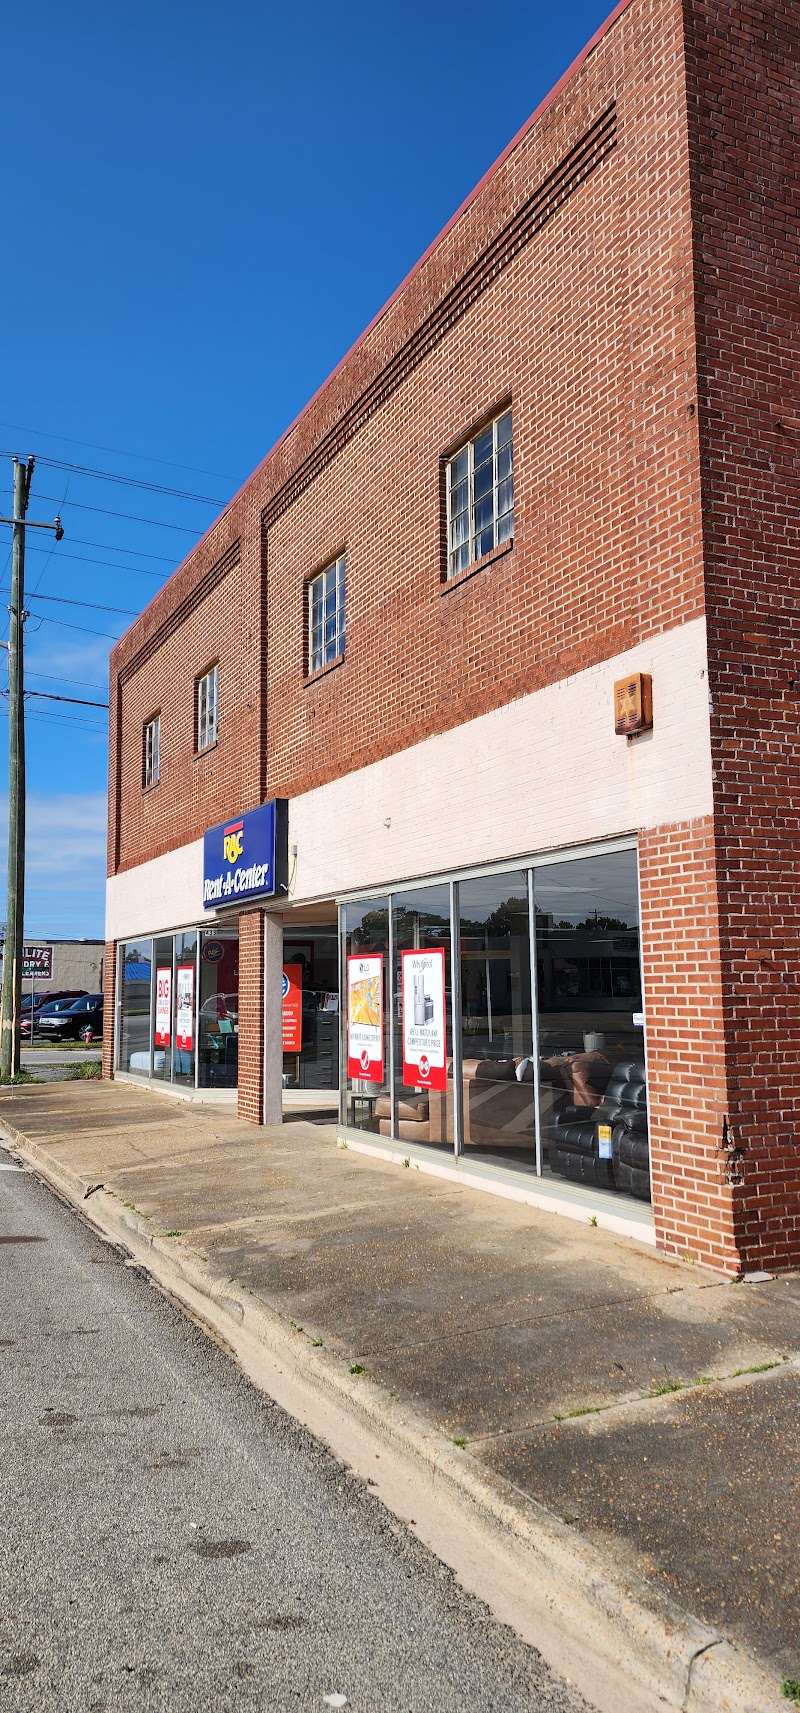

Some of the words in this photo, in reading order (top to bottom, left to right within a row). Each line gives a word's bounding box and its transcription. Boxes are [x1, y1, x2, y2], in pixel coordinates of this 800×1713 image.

[223, 830, 244, 864] RAC
[22, 960, 42, 968] DRY
[158, 979, 169, 998] BIG
